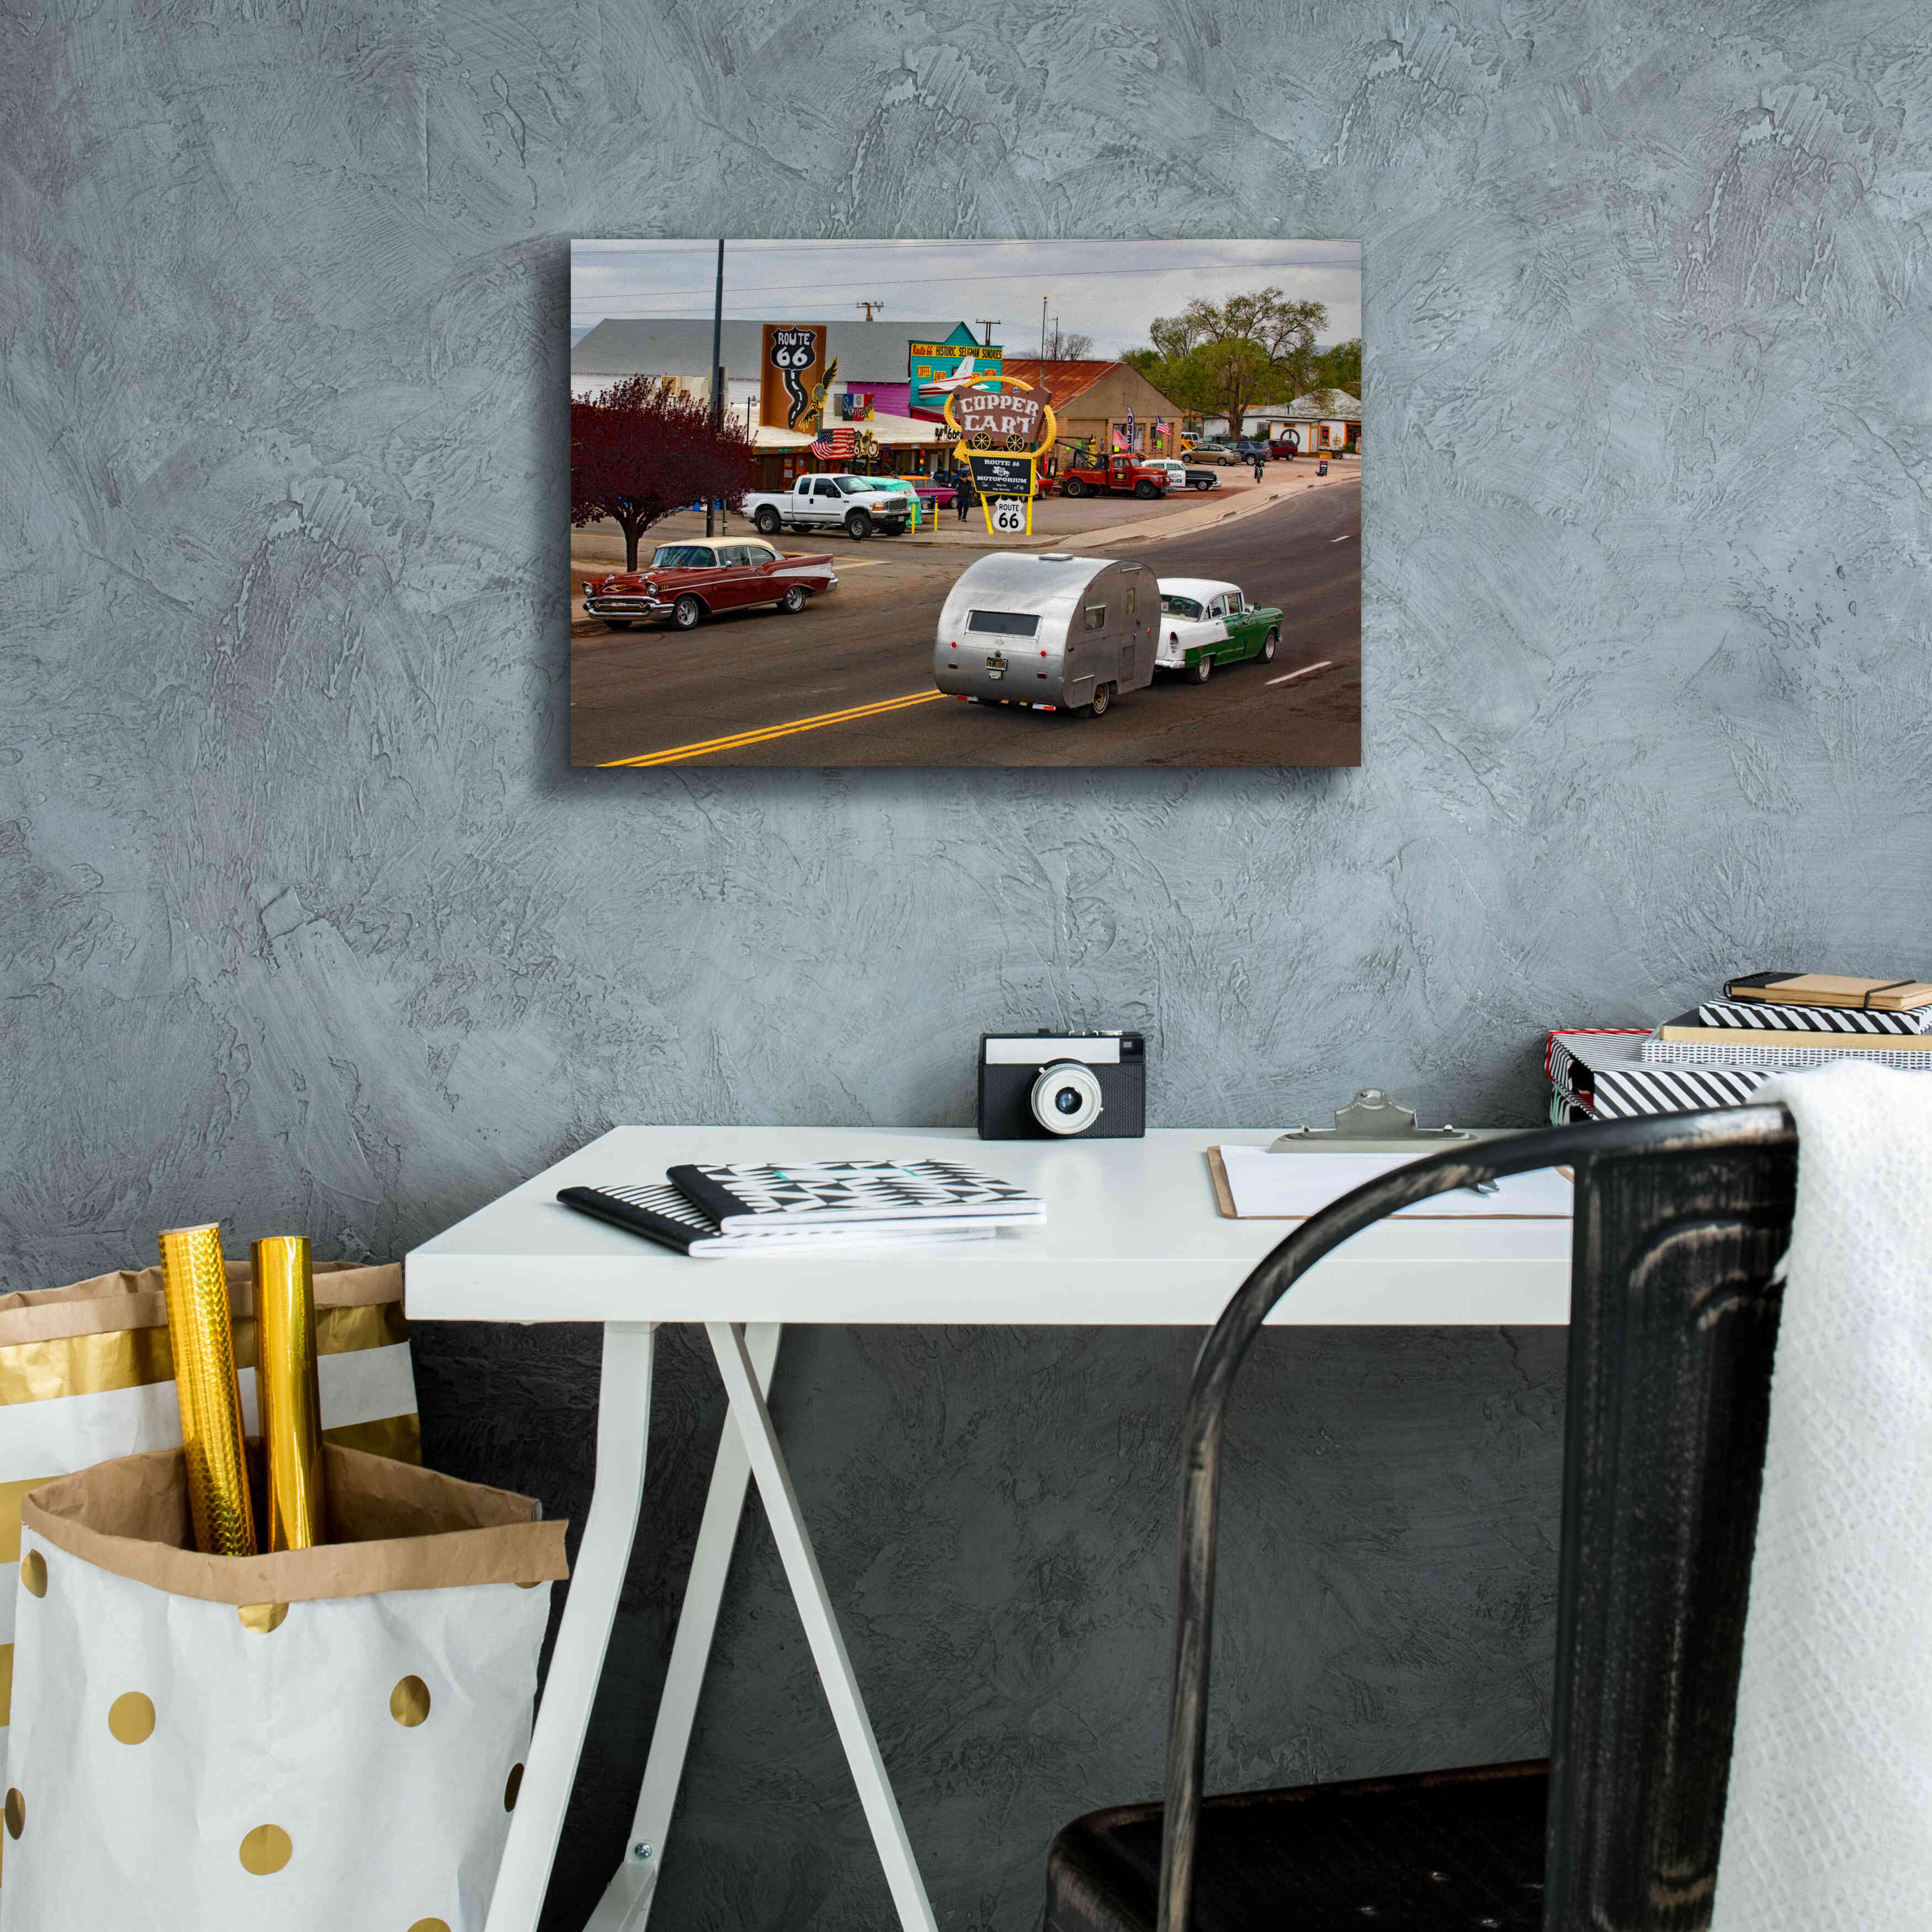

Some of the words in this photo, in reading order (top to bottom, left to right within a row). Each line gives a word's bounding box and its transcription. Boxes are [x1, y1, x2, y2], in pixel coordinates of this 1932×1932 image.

[778, 332, 810, 345] ROUTE
[777, 347, 808, 367] 66
[912, 344, 926, 355] Route
[927, 346, 933, 355] 66
[936, 346, 956, 357] HISTORIC
[959, 347, 980, 358] SELIGMAN
[982, 348, 1002, 359] SUNDRIES
[959, 395, 1039, 417] COPPER
[964, 415, 1036, 434] CART
[976, 475, 1027, 484] MOTOPORIUM
[999, 503, 1020, 512] ROUTE
[999, 512, 1019, 529] 66
